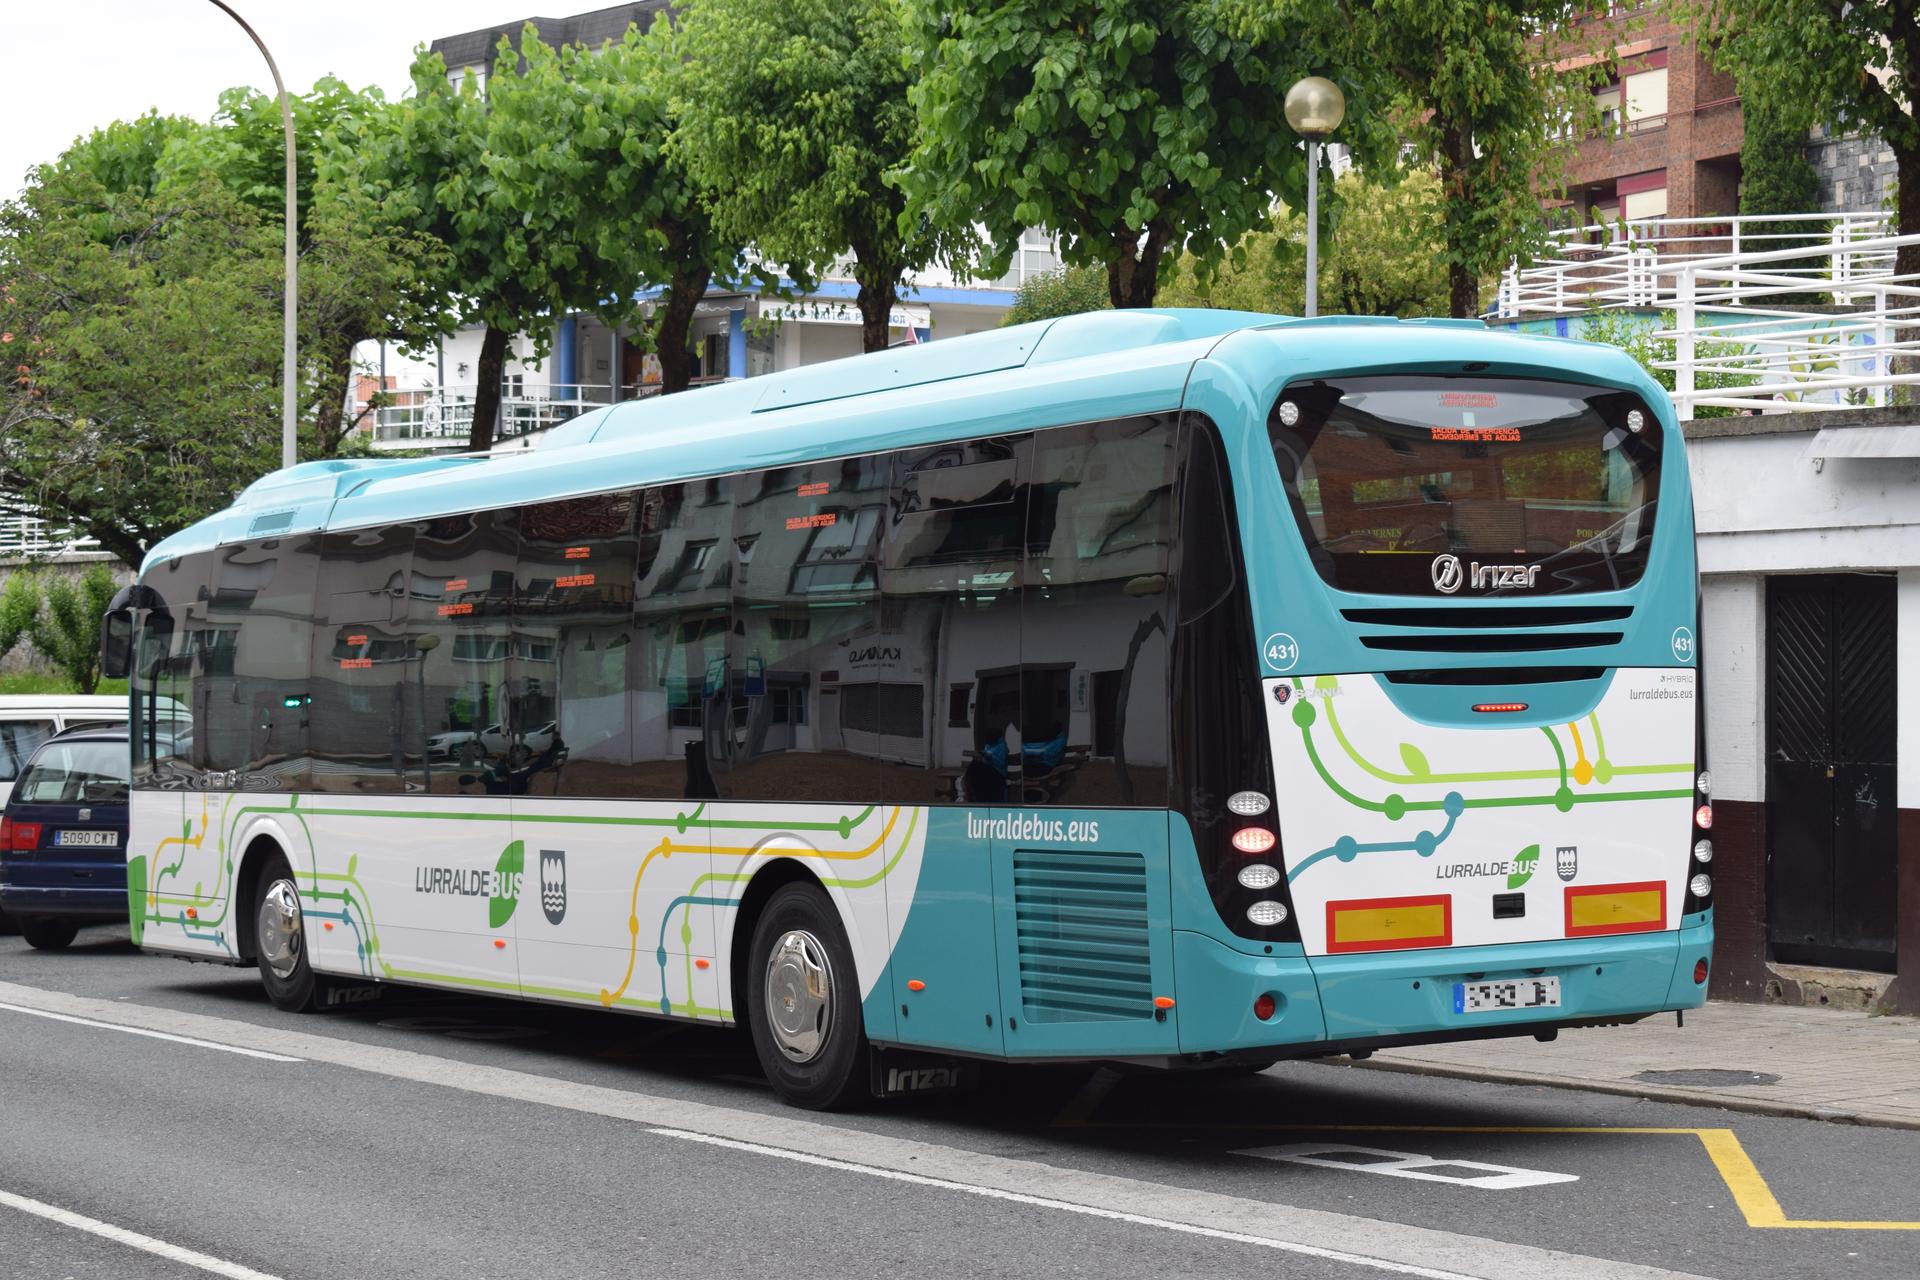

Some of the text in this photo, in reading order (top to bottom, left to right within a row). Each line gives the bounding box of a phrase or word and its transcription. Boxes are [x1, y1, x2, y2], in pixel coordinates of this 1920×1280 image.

[1268, 643, 1295, 660] 431
[1674, 637, 1692, 652] 431
[1629, 688, 1693, 700] lurraldebus.eus
[967, 811, 1099, 843] lurraldebus.eus
[63, 832, 91, 844] 5090
[1436, 860, 1538, 879] LURRALDEBUS
[415, 866, 523, 900] LURRALDEBUS
